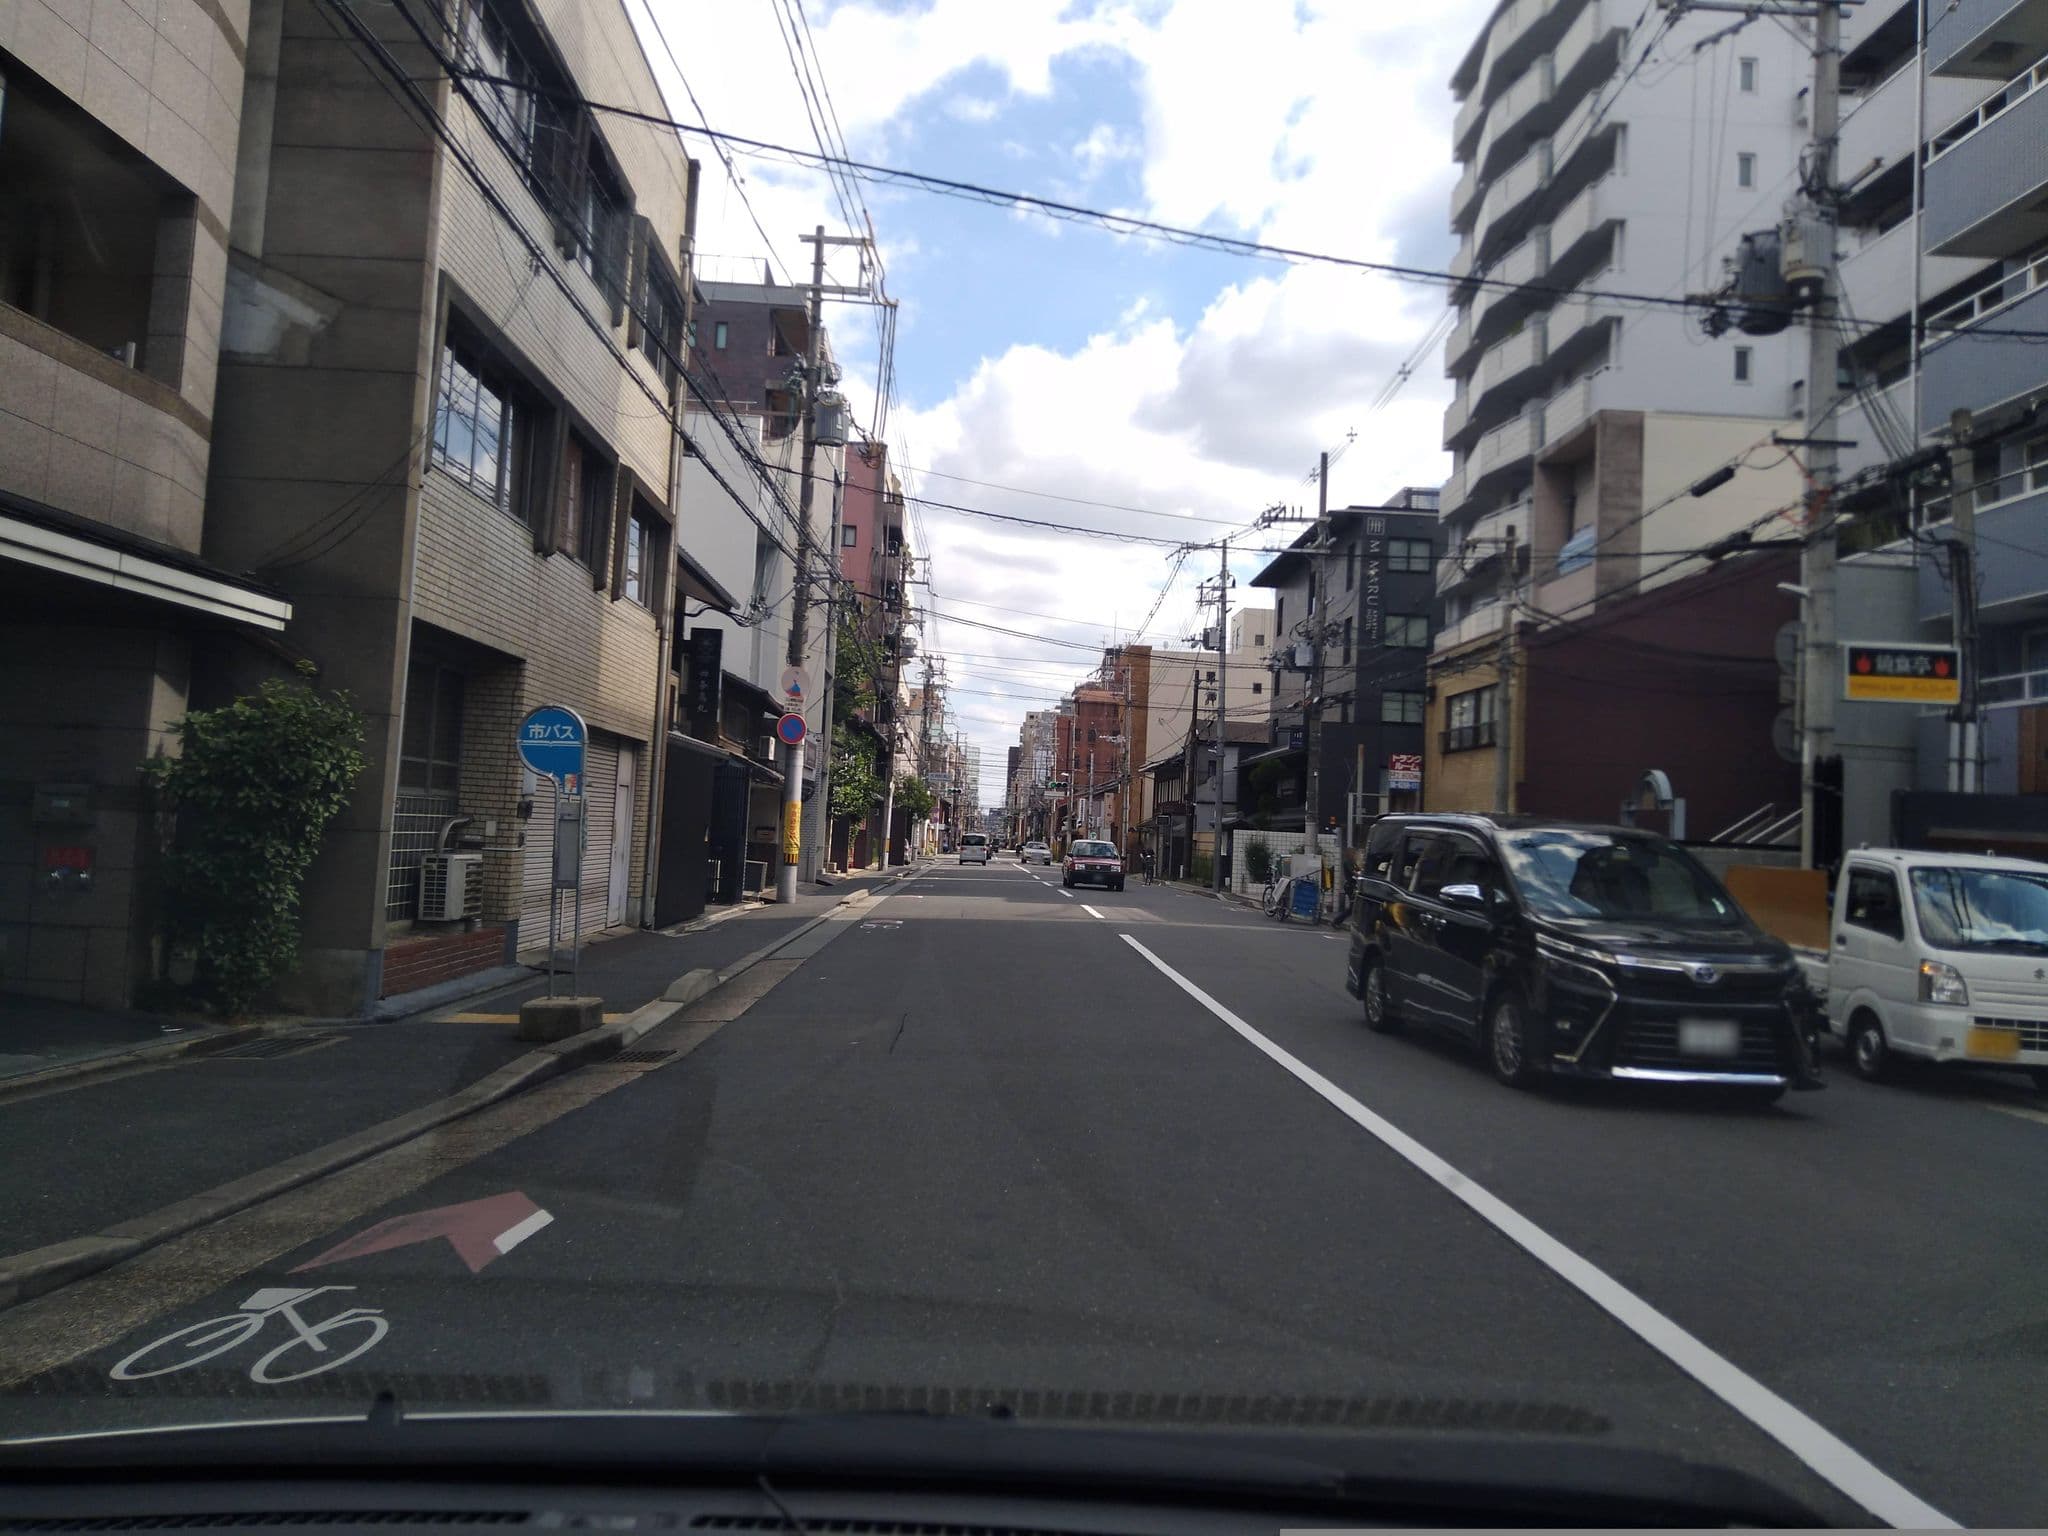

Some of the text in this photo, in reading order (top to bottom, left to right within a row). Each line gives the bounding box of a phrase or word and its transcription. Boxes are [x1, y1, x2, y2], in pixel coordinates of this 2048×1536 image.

[1367, 539, 1380, 606] MMARU
[528, 724, 574, 739] 市バス
[1392, 754, 1422, 763] トランク
[1394, 761, 1420, 771] ルーム
